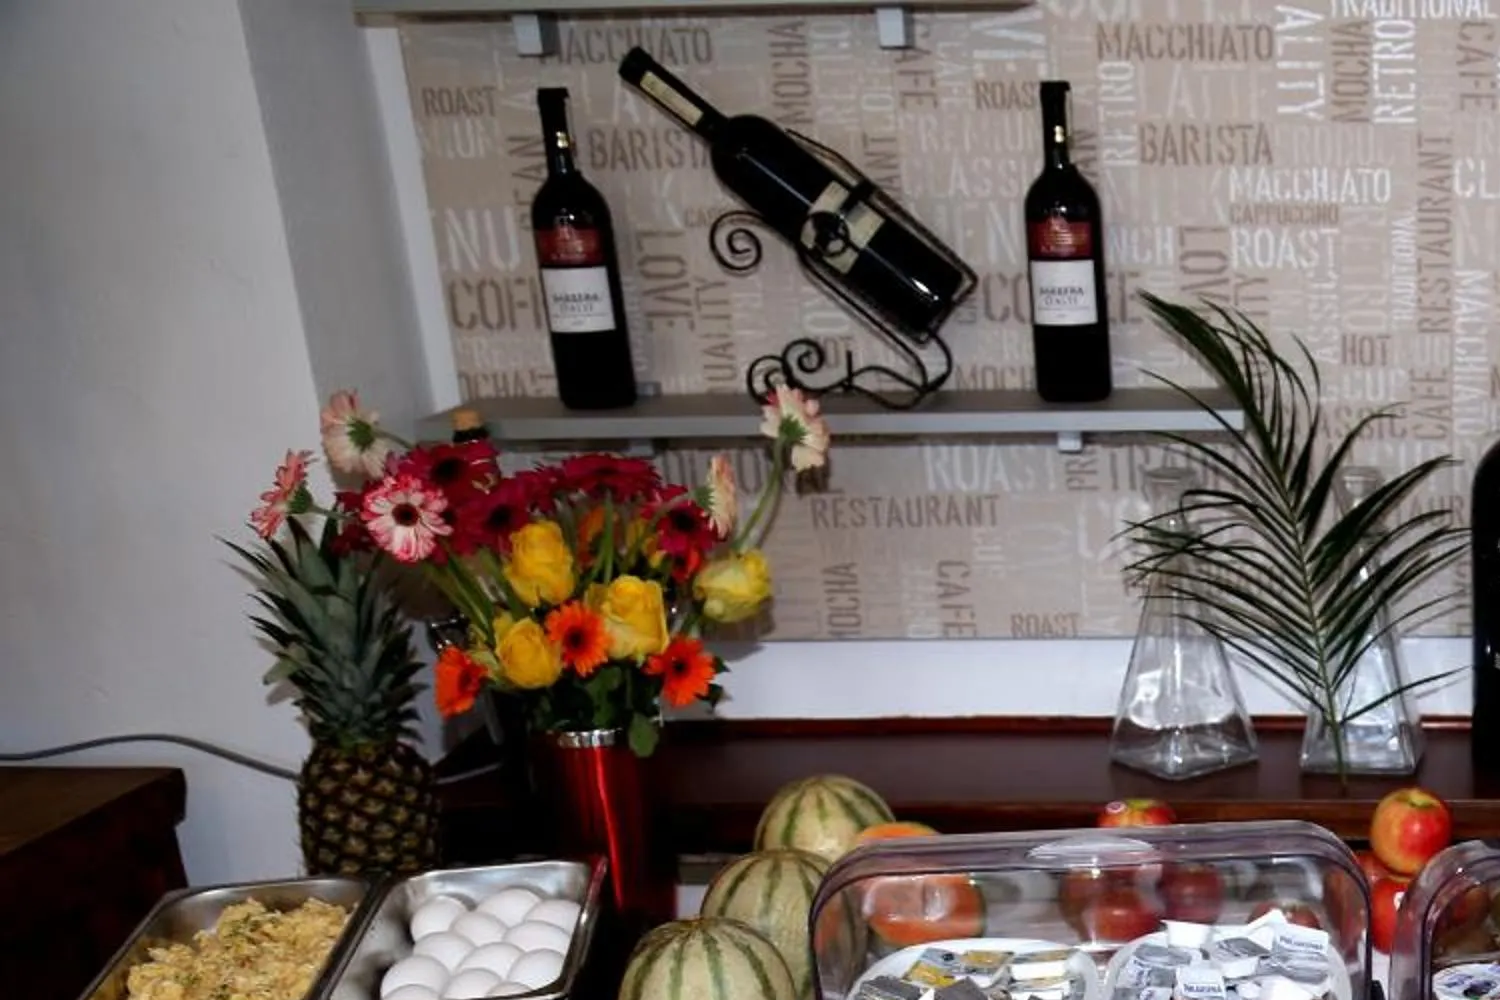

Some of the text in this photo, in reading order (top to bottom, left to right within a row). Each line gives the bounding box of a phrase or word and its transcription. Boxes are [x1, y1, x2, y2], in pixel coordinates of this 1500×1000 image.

[1096, 21, 1275, 63] MACCHIATO
[1456, 20, 1498, 111] CAFE
[767, 20, 814, 124] MOCHA
[1329, 19, 1370, 123] MOCHA
[1371, 19, 1417, 124] RETRO
[422, 86, 498, 117] ROAST
[972, 79, 1040, 112] ROAS
[1097, 60, 1139, 167] RETRO
[1137, 120, 1275, 167] BARISTA
[1228, 166, 1391, 204] MACCHIATO
[1229, 227, 1340, 269] ROAST
[1416, 129, 1453, 334] RESTAURANT
[1340, 332, 1393, 367] HOT
[1407, 367, 1452, 440] CAFE
[922, 445, 1058, 493] ROAST
[811, 493, 1000, 530] RESTAURANT
[936, 559, 977, 638] CAFE
[1010, 611, 1081, 638] ROAST
